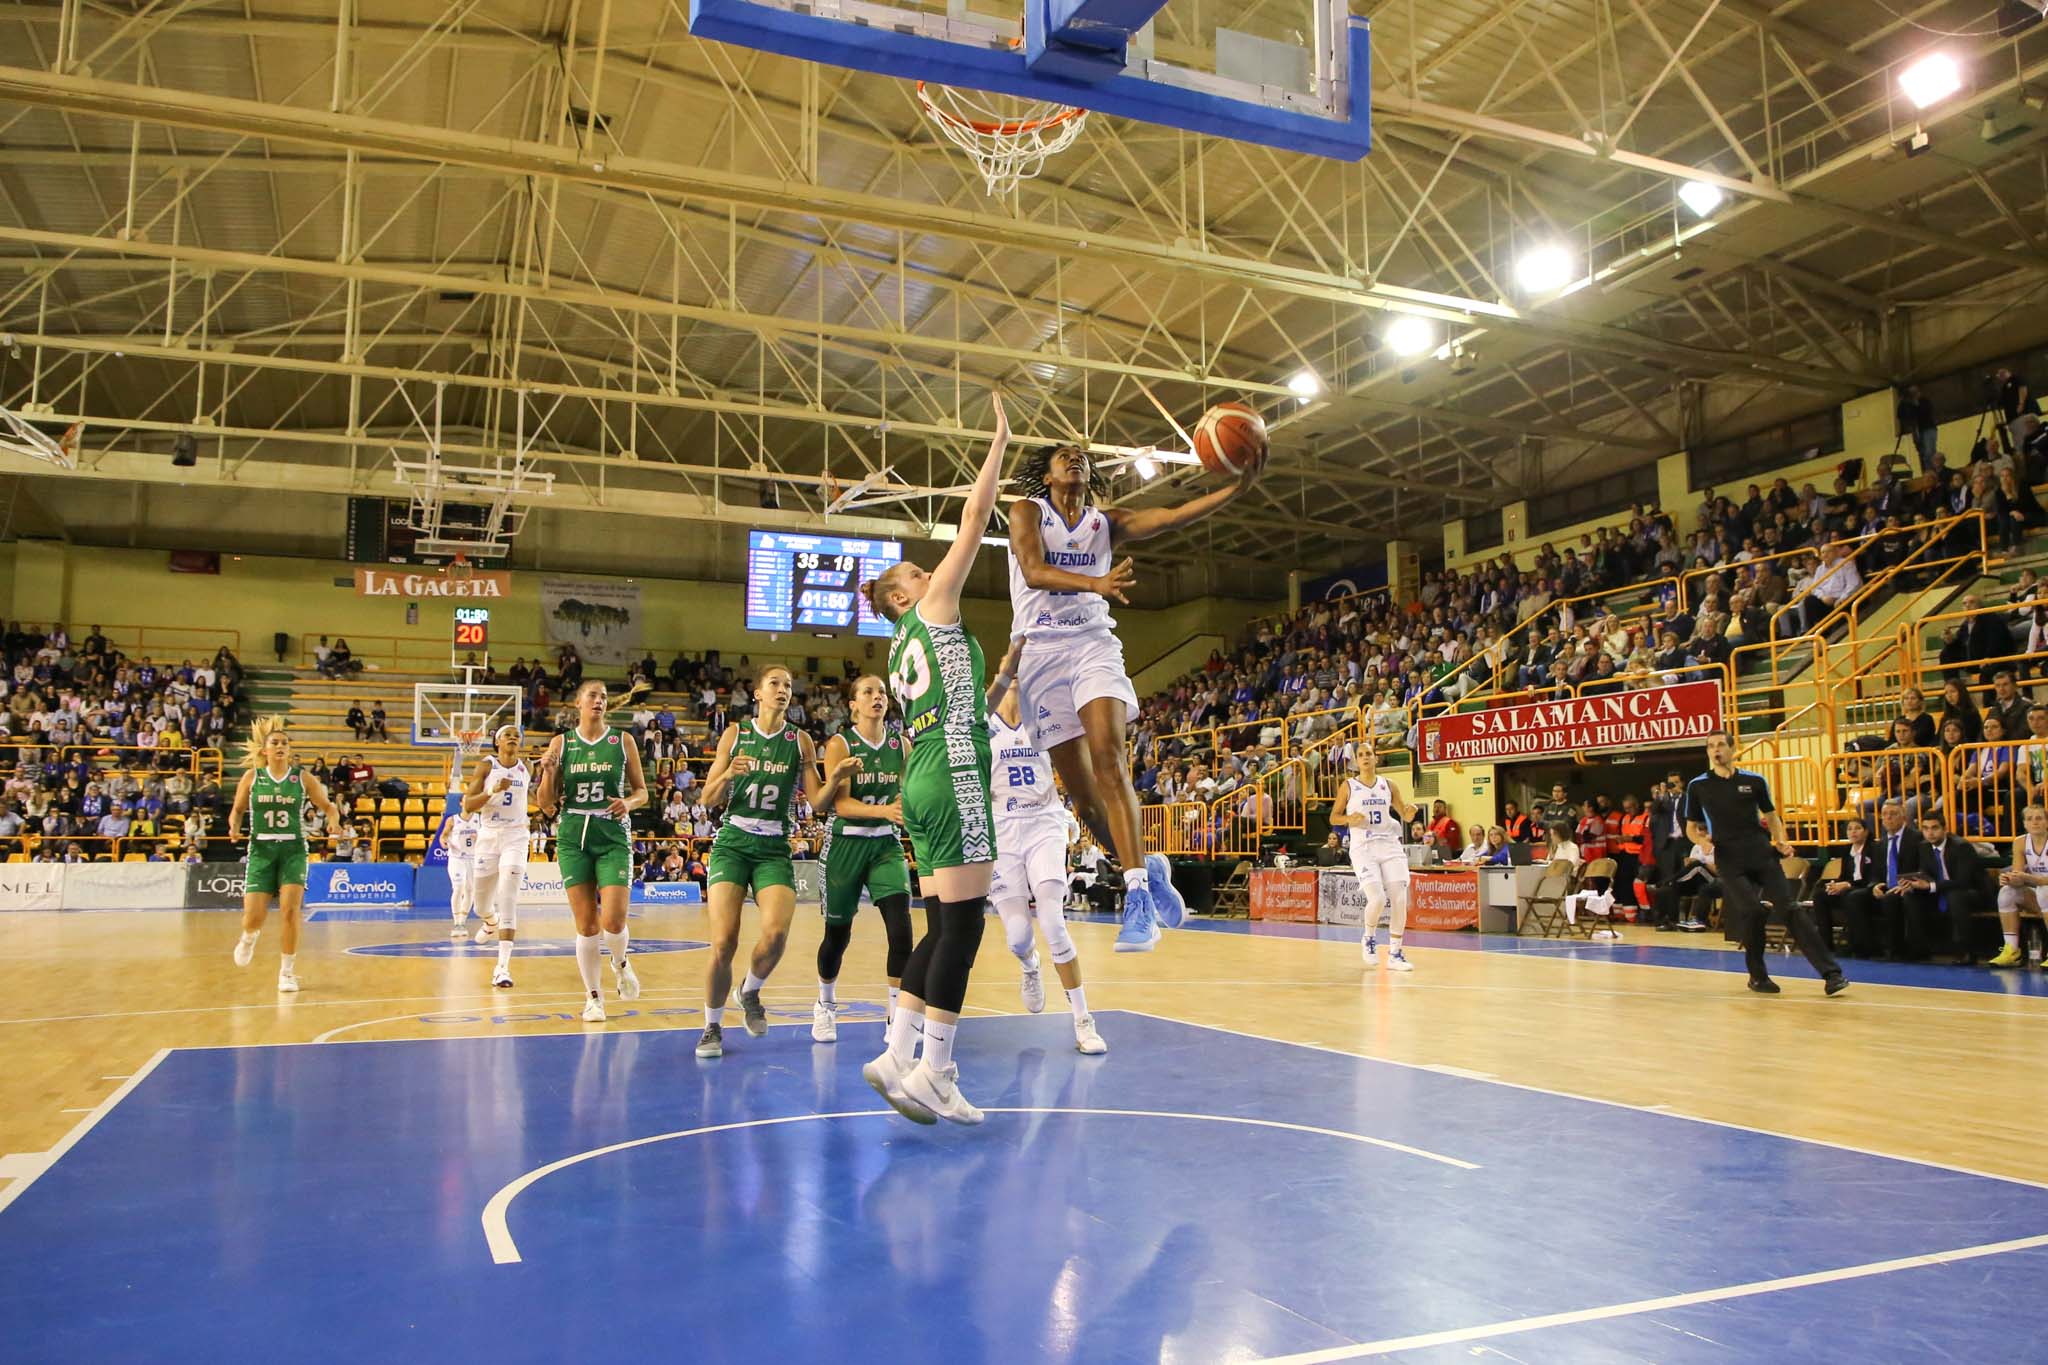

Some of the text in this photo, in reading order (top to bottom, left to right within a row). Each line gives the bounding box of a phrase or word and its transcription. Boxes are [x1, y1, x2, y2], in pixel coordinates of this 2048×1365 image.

[797, 552, 855, 572] 35 18
[1045, 551, 1097, 567] AVENIDA
[364, 570, 502, 597] LA GACETA
[801, 591, 849, 610] 01:50
[456, 608, 488, 621] 01:50
[803, 609, 814, 623] 2
[456, 624, 484, 644] 20
[1472, 690, 1679, 737] SALAMANCA
[1445, 713, 1714, 760] PATRIMONIO DE LA HUMANIDAD
[1000, 747, 1040, 760] AVENIDA
[1007, 765, 1036, 787] 28
[501, 791, 513, 807] 3
[575, 780, 605, 804] 55
[744, 783, 780, 810] 12
[263, 810, 290, 829] 13
[1368, 810, 1382, 825] 13
[465, 838, 473, 847] 6
[336, 879, 397, 893] avenida
[1415, 879, 1477, 895] Ayuntamiento
[1416, 895, 1477, 911] de Salamanca
